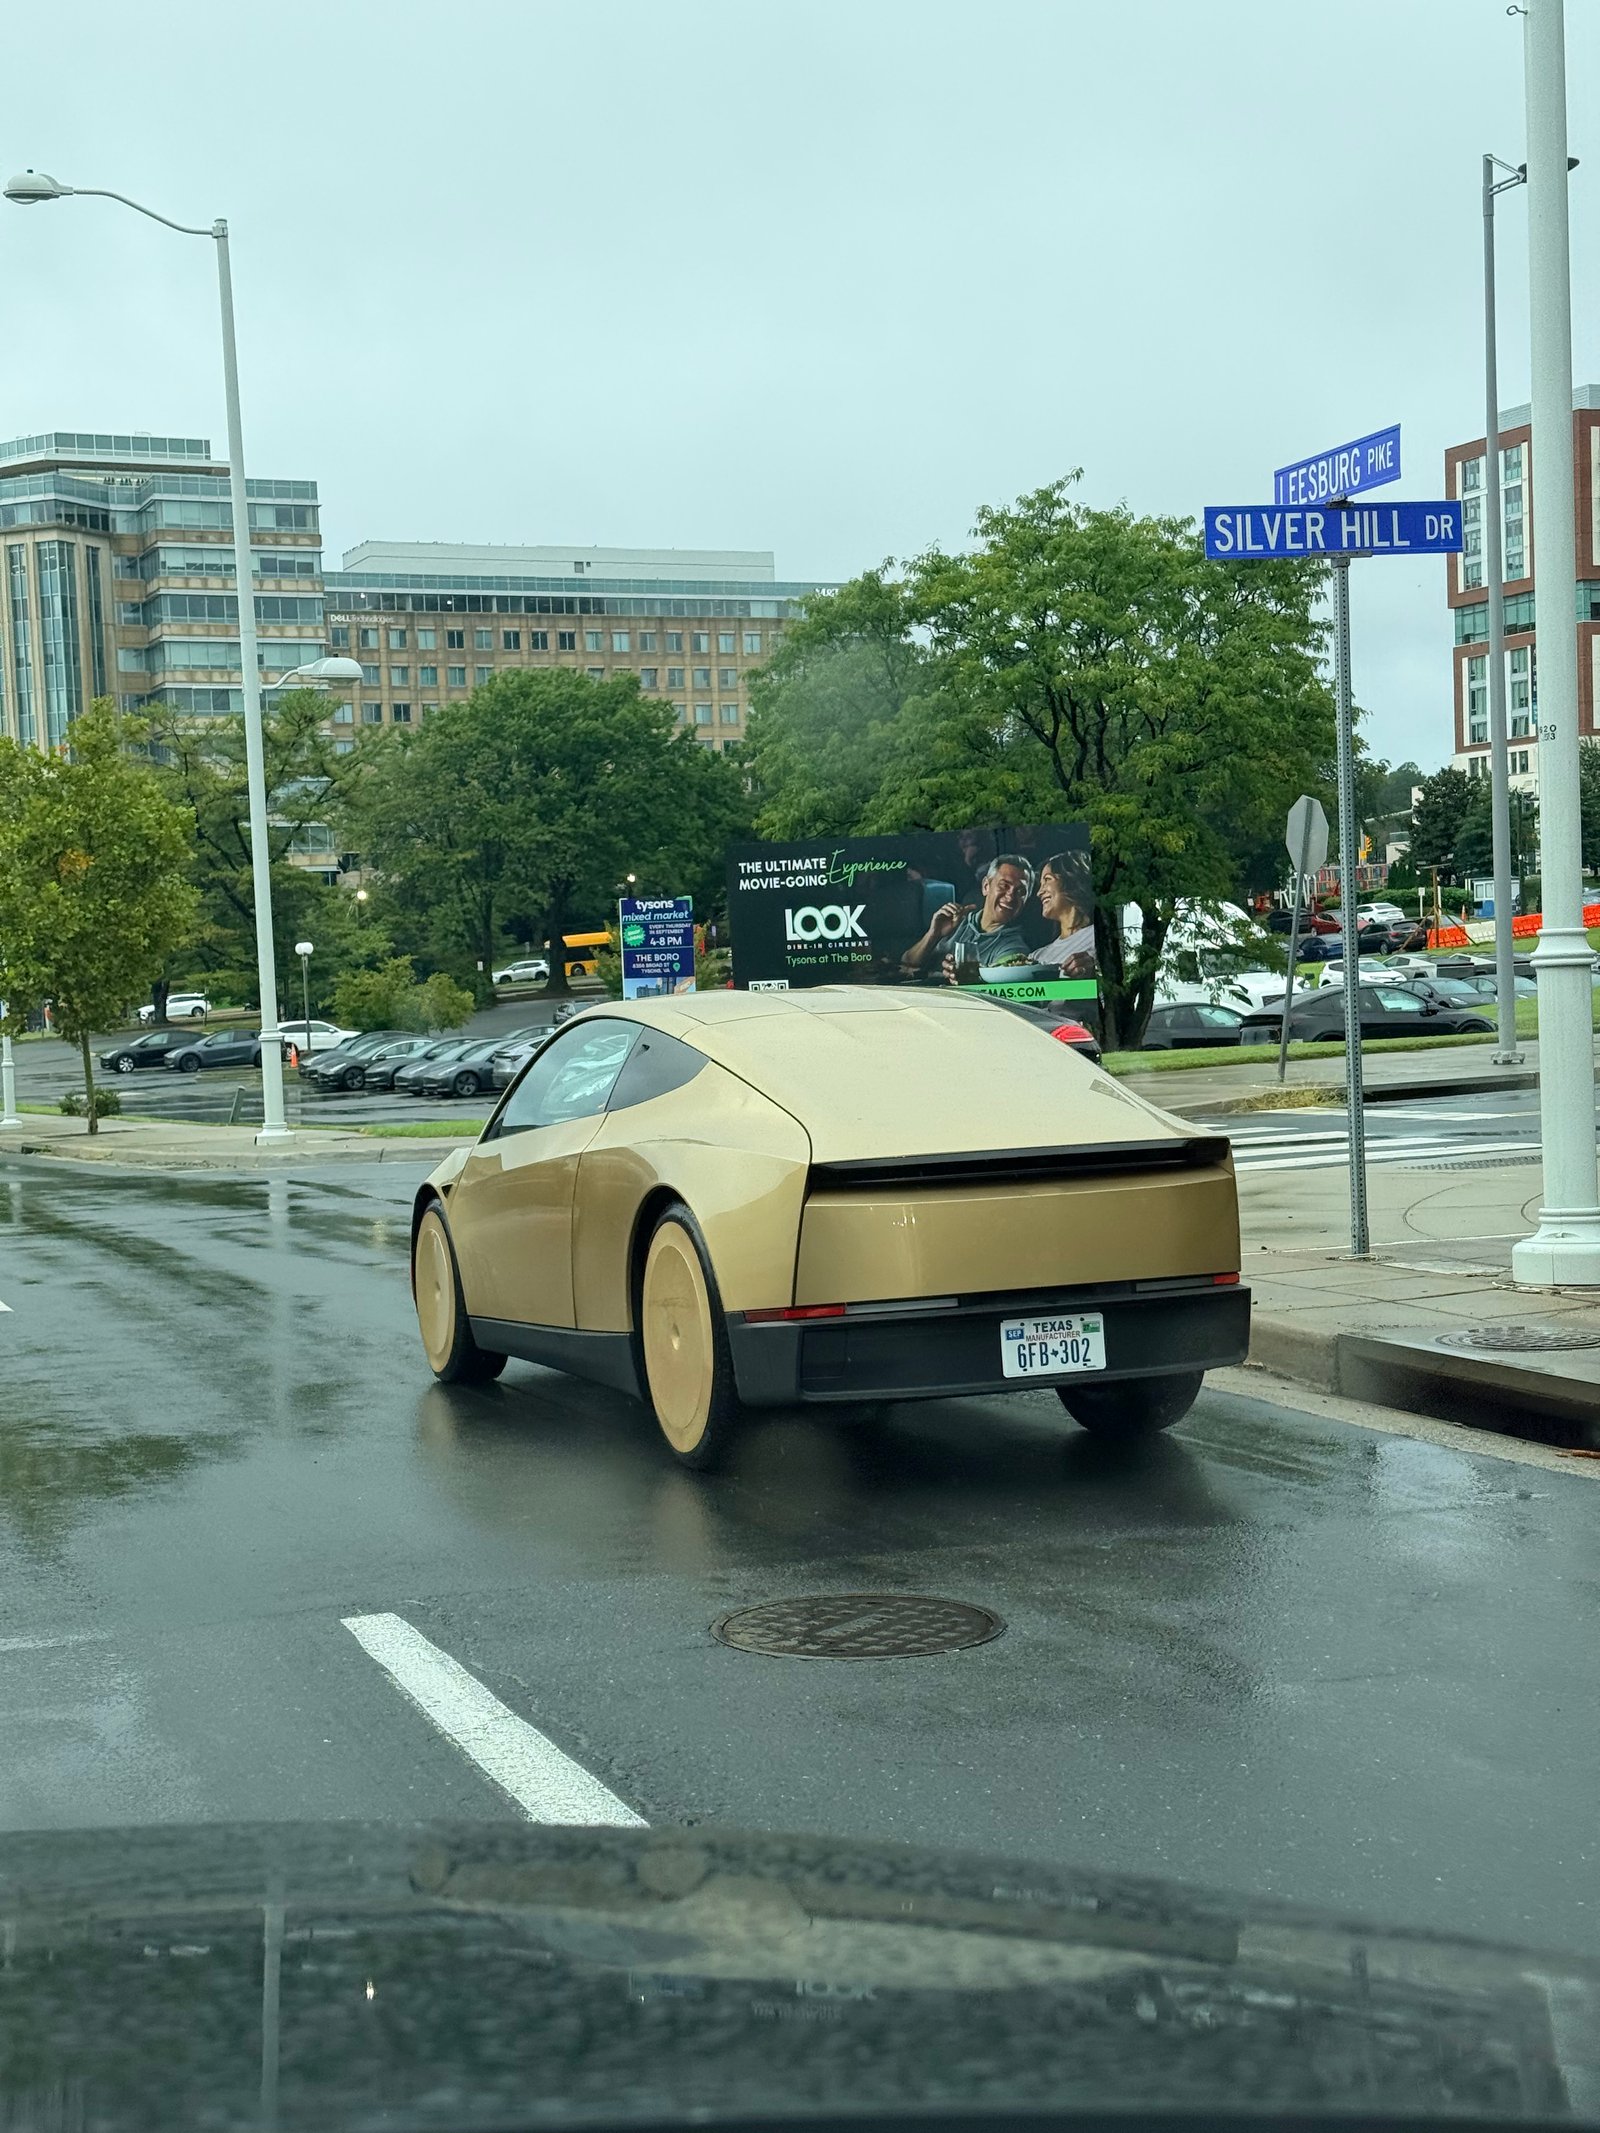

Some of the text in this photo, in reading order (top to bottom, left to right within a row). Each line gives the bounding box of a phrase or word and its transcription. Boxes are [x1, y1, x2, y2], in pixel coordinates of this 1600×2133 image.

[1368, 440, 1394, 475] PIKE
[1214, 510, 1454, 551] SILVER HILL DR
[739, 848, 907, 887] THE ULTIMATE Experience
[739, 874, 828, 890] MOVIE-GOING
[635, 900, 674, 912] tysons
[622, 910, 689, 922] mixed market
[785, 904, 868, 941] LOOK
[650, 936, 682, 946] 4-8 PM
[635, 953, 680, 962] THE BORO
[785, 952, 872, 967] Tysons at The Boro
[981, 987, 1046, 998] MAS.COM
[1007, 1330, 1022, 1338] SEP
[1033, 1320, 1073, 1333] TEXAS
[1025, 1330, 1081, 1341] MANUFACTURER
